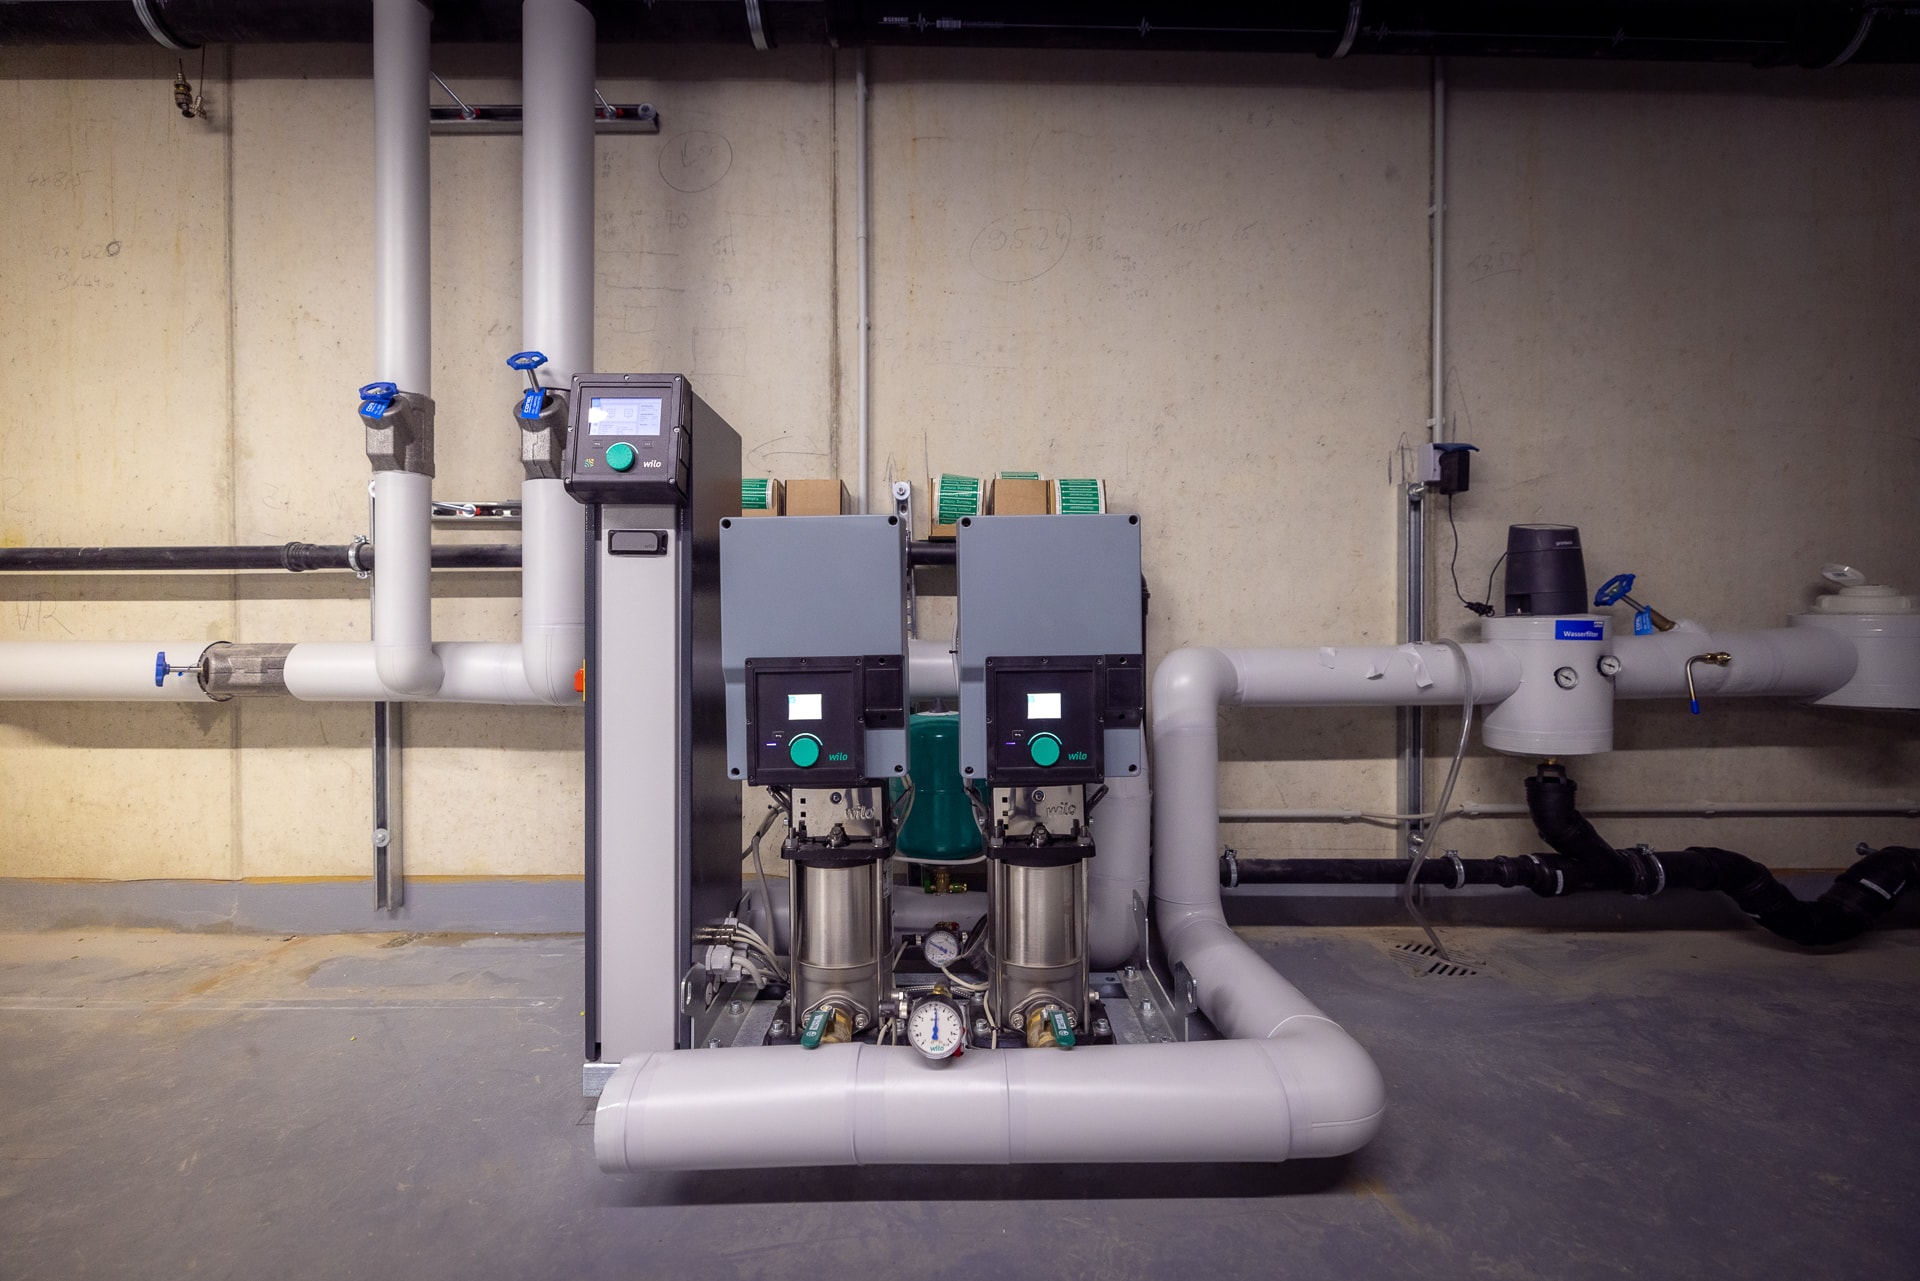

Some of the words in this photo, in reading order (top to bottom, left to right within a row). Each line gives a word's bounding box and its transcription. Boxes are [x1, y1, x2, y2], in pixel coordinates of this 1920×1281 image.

[643, 459, 662, 469] wilo
[828, 752, 849, 761] wilo
[1068, 751, 1088, 761] wilo
[845, 803, 875, 820] wilo
[1046, 802, 1077, 818] wilo
